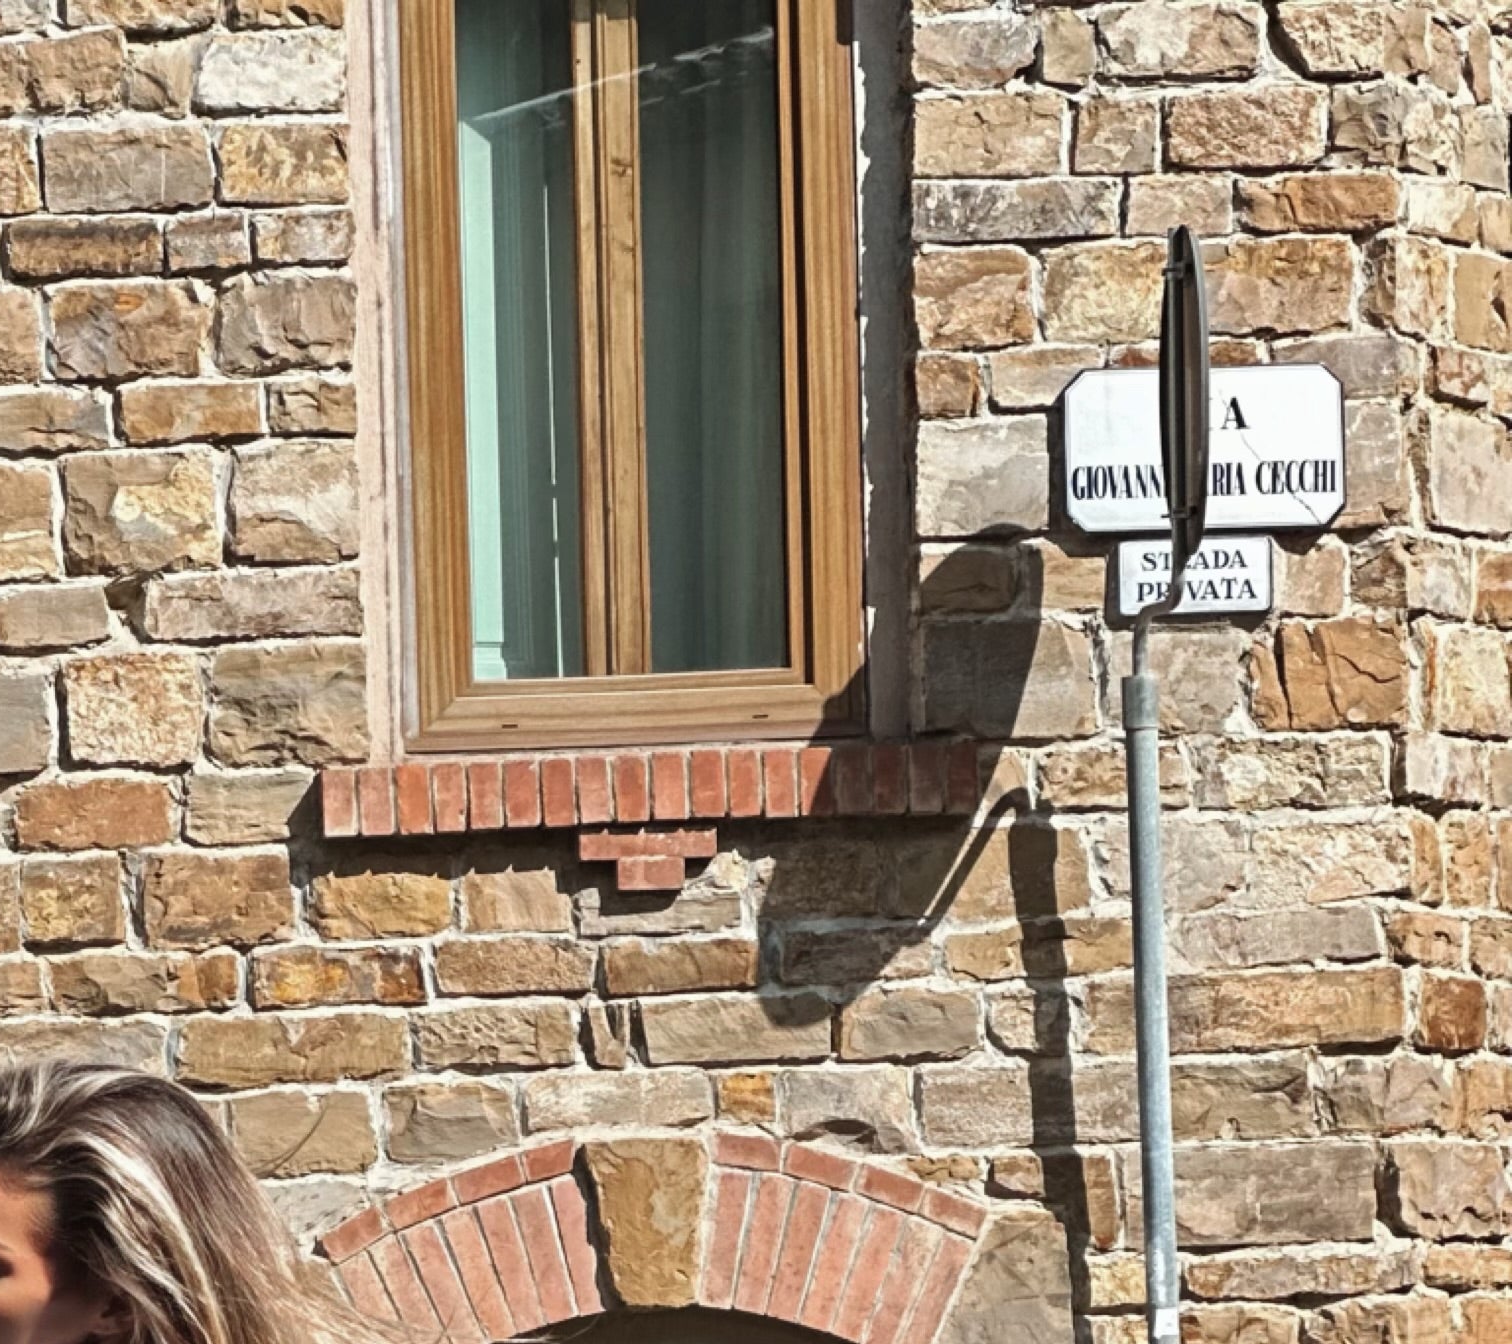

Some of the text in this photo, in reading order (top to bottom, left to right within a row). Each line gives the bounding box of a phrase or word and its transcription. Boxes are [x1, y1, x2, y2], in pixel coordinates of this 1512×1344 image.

[1071, 459, 1337, 500] GIOVANN RIA CECCHI
[1140, 549, 1249, 571] STADA
[1137, 578, 1258, 603] PRVATA
